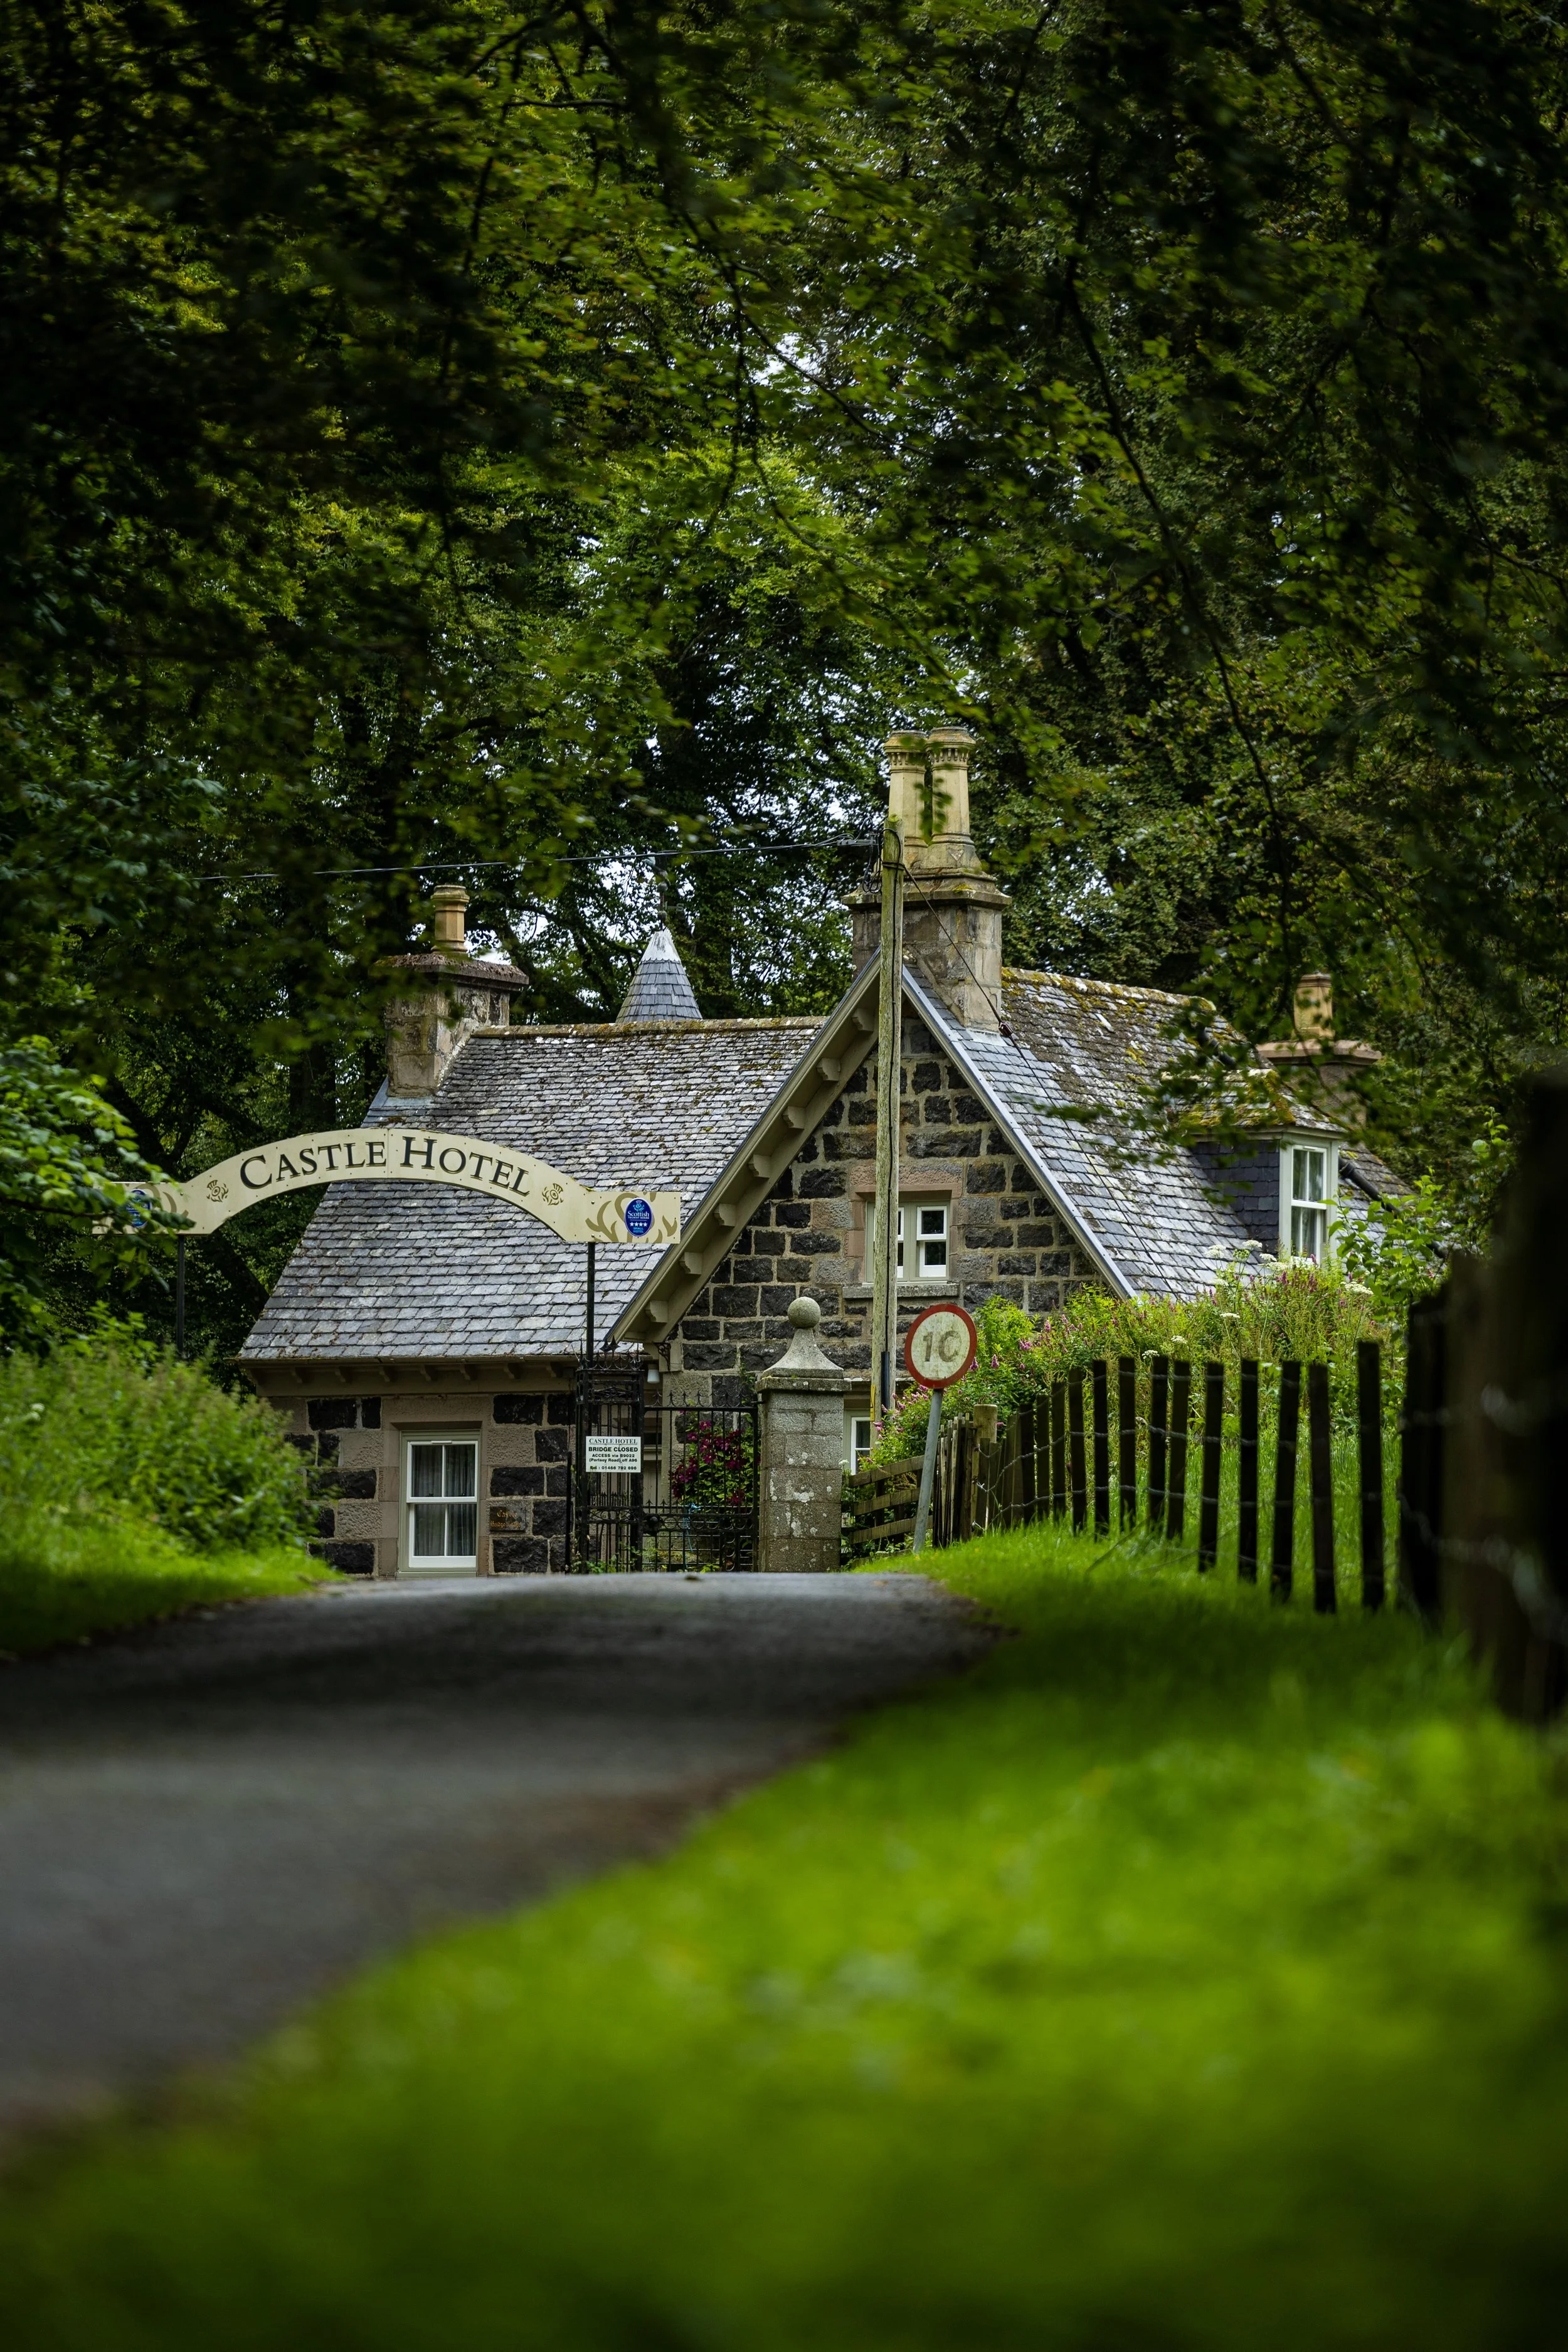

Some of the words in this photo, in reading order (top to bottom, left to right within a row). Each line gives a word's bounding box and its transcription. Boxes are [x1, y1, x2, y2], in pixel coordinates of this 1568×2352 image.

[240, 1141, 387, 1190] CASTLE
[400, 1136, 531, 1197] HOTEL
[923, 1330, 962, 1362] 10
